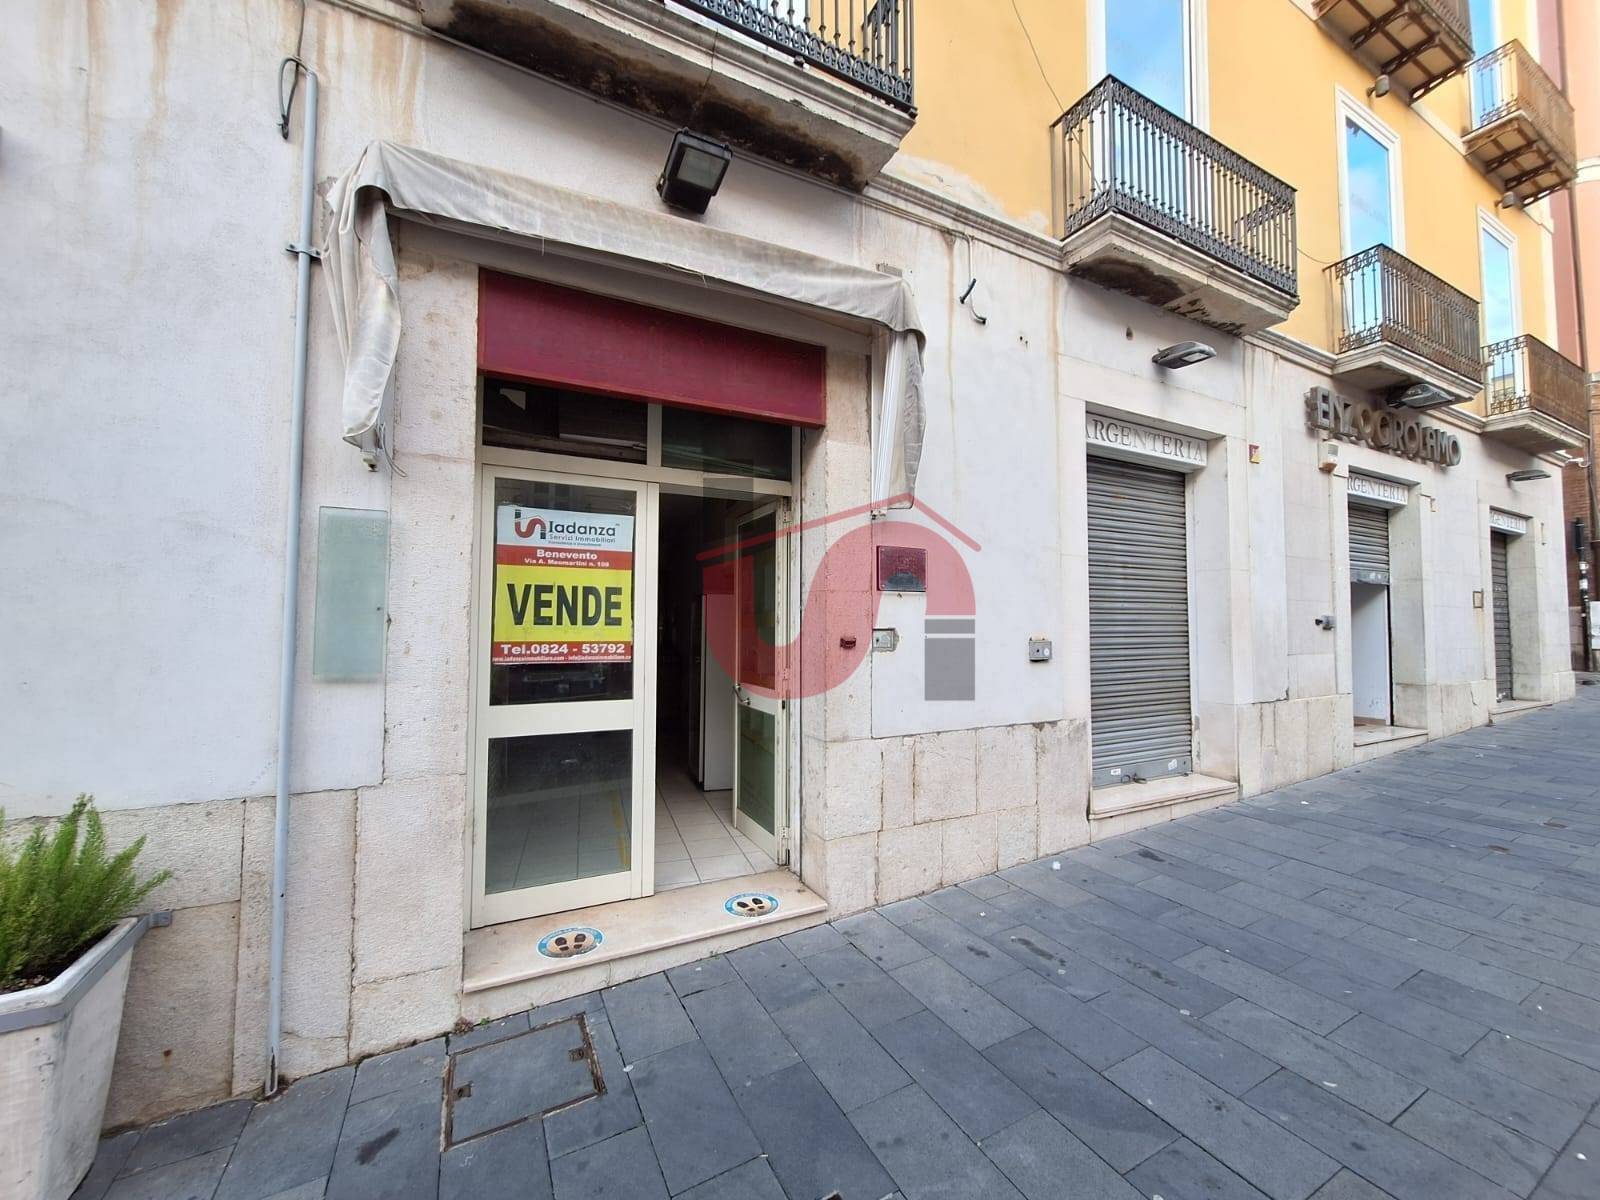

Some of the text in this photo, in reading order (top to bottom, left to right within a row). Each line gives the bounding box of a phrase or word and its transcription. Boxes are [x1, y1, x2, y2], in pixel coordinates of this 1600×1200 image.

[1347, 475, 1408, 504] RGENTERIA
[549, 520, 616, 537] Iadanza
[549, 533, 574, 541] Servizi
[575, 535, 616, 544] Immobiliari
[536, 549, 598, 560] Benevento
[506, 583, 623, 626] VENDE
[500, 643, 569, 655] Tel.0824
[582, 643, 625, 653] 53792
